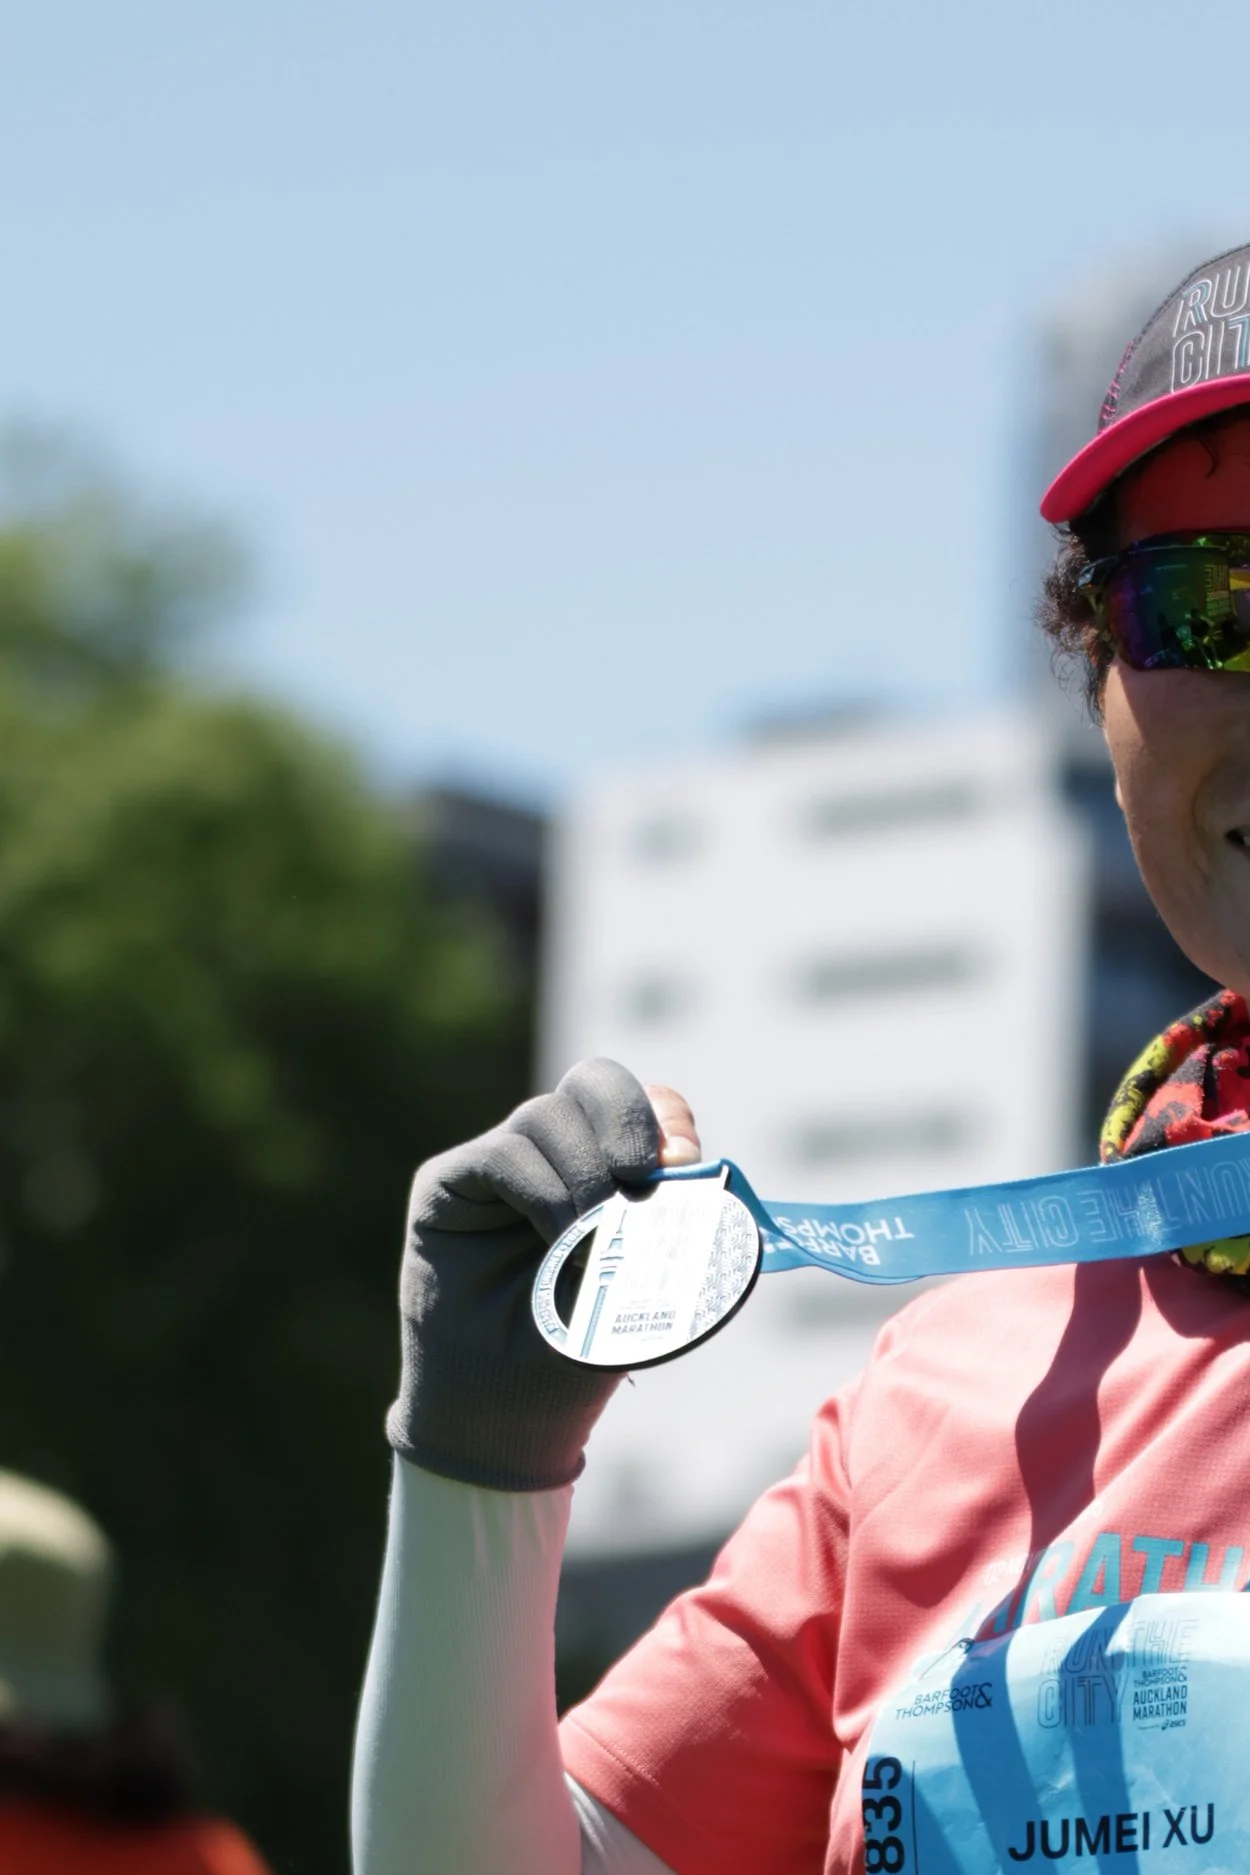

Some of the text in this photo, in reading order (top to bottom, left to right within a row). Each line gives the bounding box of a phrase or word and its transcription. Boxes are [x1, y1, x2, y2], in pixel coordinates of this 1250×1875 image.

[963, 1194, 1079, 1256] CITY
[1041, 1619, 1199, 1676] RUN THE
[896, 1698, 975, 1720] THOMPSON
[1037, 1671, 1132, 1729] CITY
[1132, 1685, 1188, 1706] AUCKLAND
[1132, 1700, 1188, 1722] MARATHON
[1008, 1802, 1215, 1862] JUMEI XU
